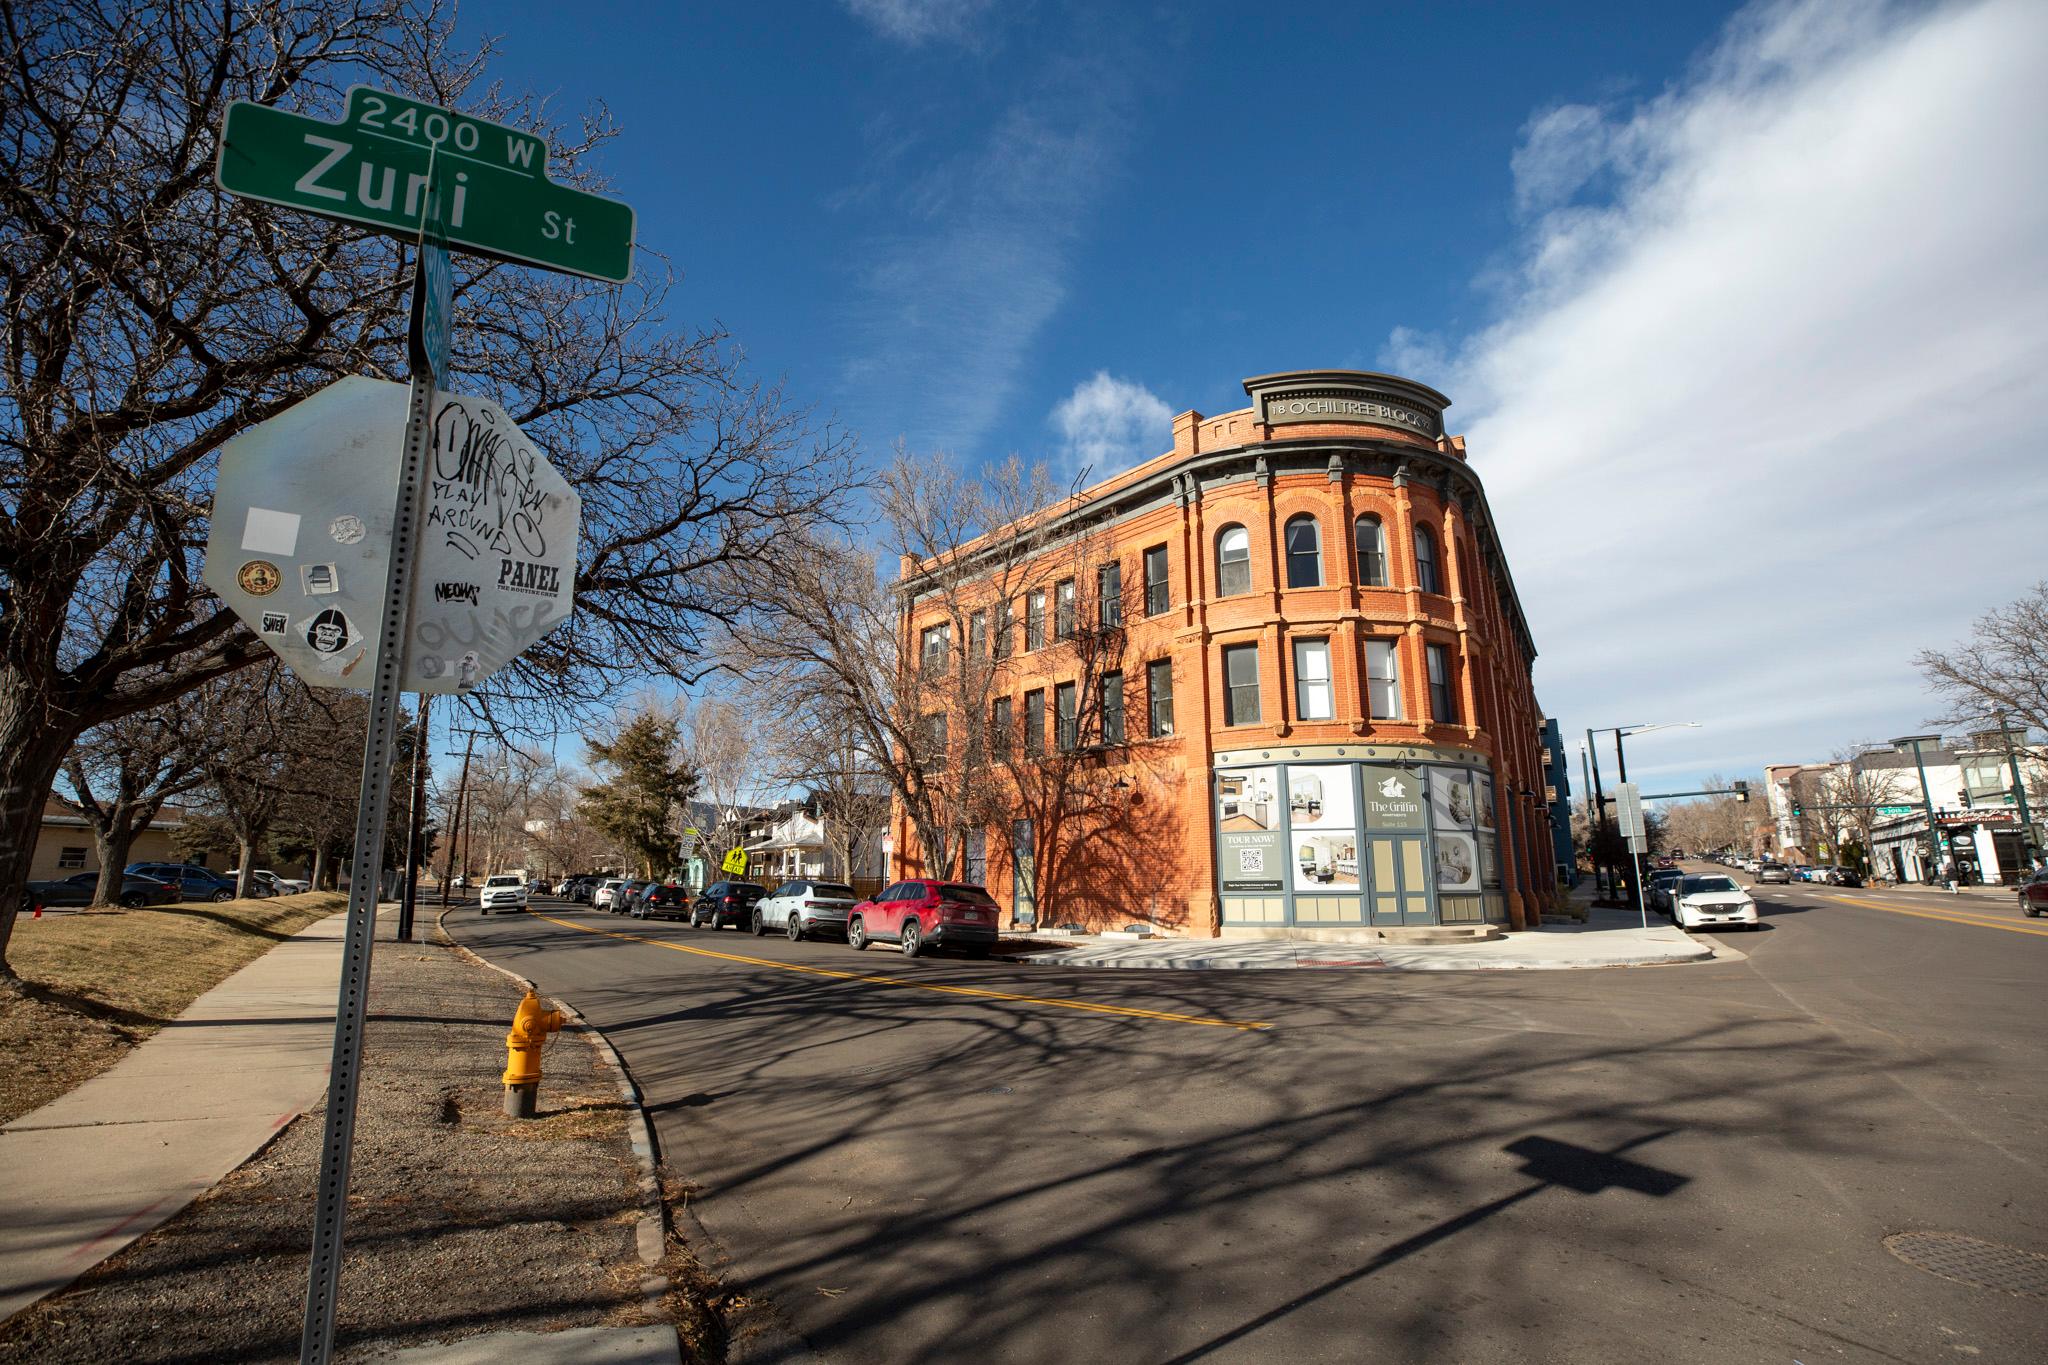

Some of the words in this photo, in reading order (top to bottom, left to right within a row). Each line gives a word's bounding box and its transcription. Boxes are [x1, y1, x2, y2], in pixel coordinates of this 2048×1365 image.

[360, 96, 480, 152] 2400
[506, 135, 536, 169] W
[294, 133, 470, 228] Zuni
[541, 210, 578, 245] St
[1289, 400, 1374, 416] OCHILTREE
[1379, 405, 1421, 427] BLOCK
[432, 481, 482, 512] PLAY
[427, 504, 512, 555] AROUND
[498, 558, 560, 593] PANEL
[1369, 801, 1388, 812] The
[1389, 801, 1418, 813] Griffin
[1227, 836, 1250, 844] TOUR
[1251, 834, 1275, 843] NOW!
